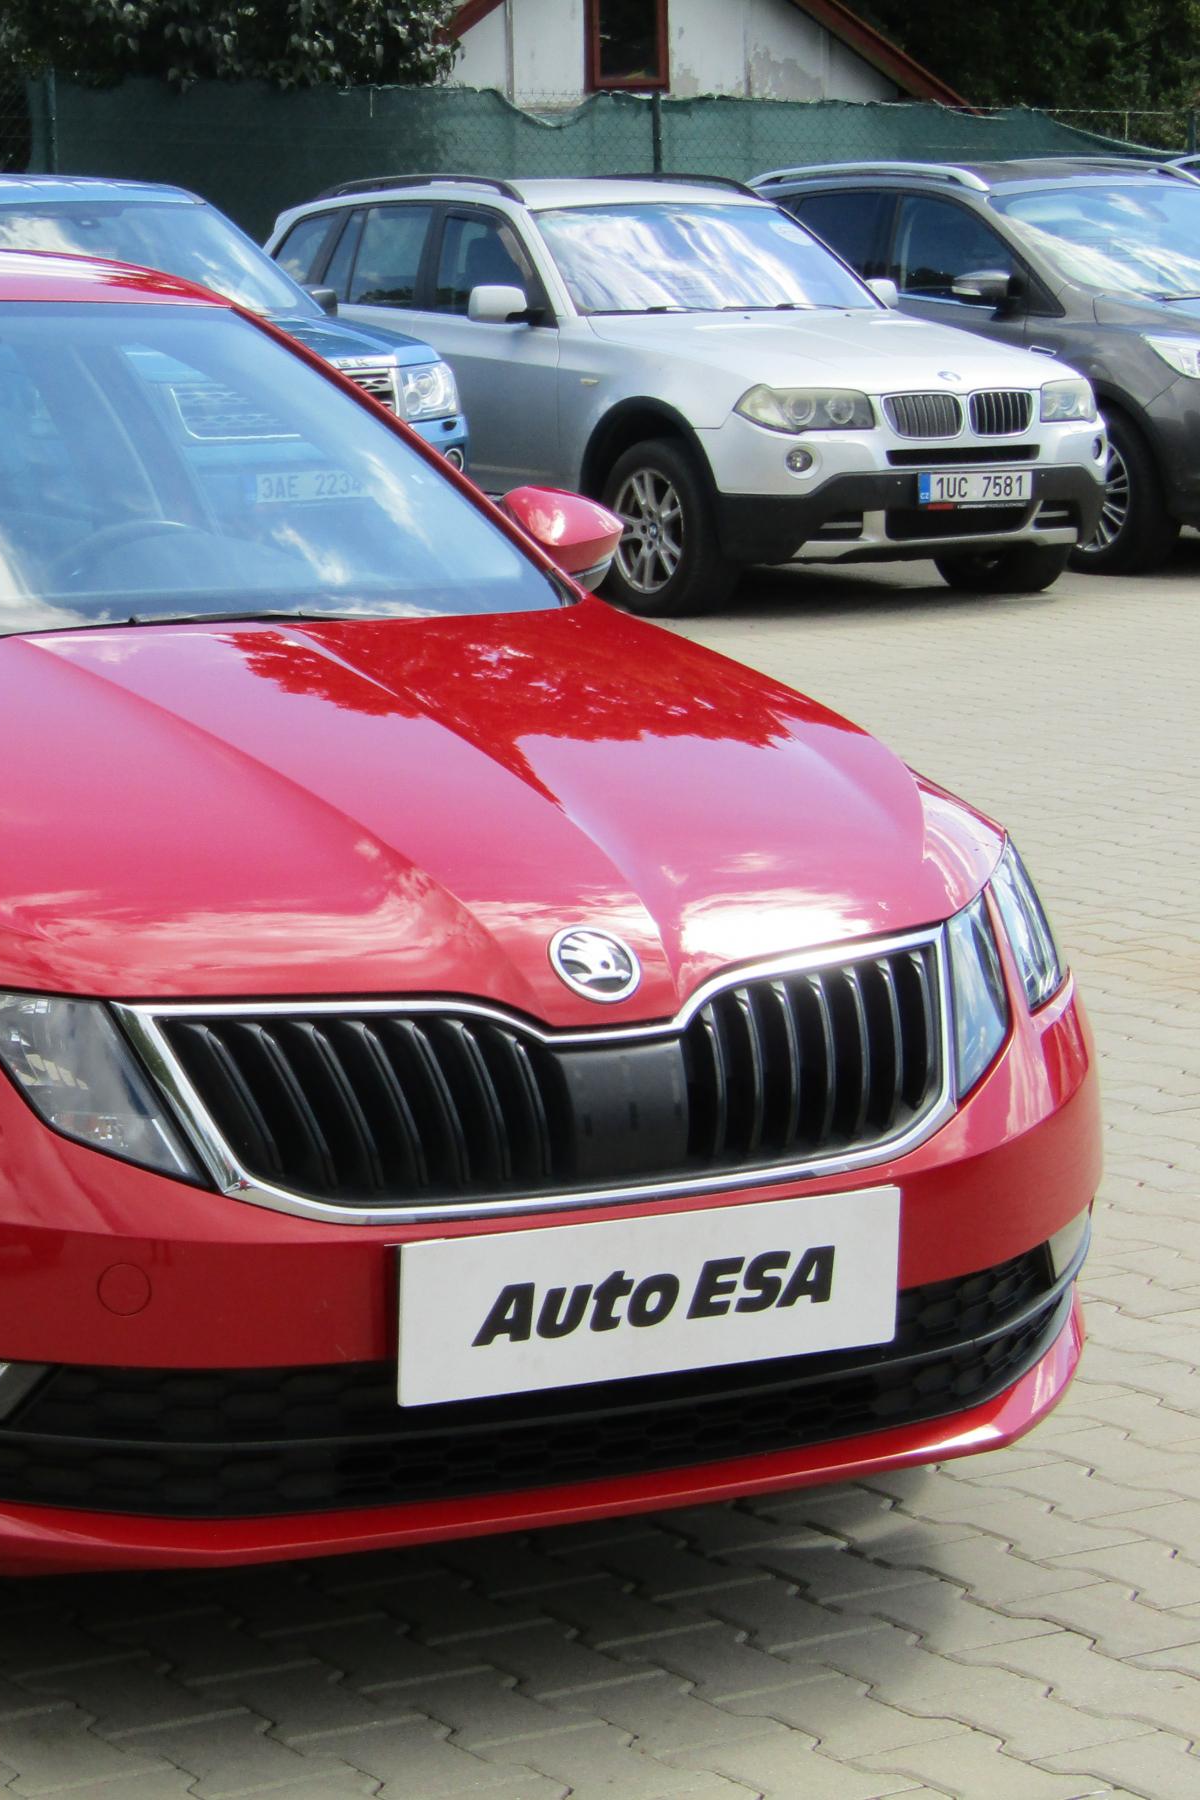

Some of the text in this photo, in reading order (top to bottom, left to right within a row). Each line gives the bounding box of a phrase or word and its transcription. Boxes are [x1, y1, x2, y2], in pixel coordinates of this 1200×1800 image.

[261, 475, 299, 499] 3AE
[936, 475, 1023, 499] 1UC 7581
[471, 1245, 836, 1347] Auto ESA
